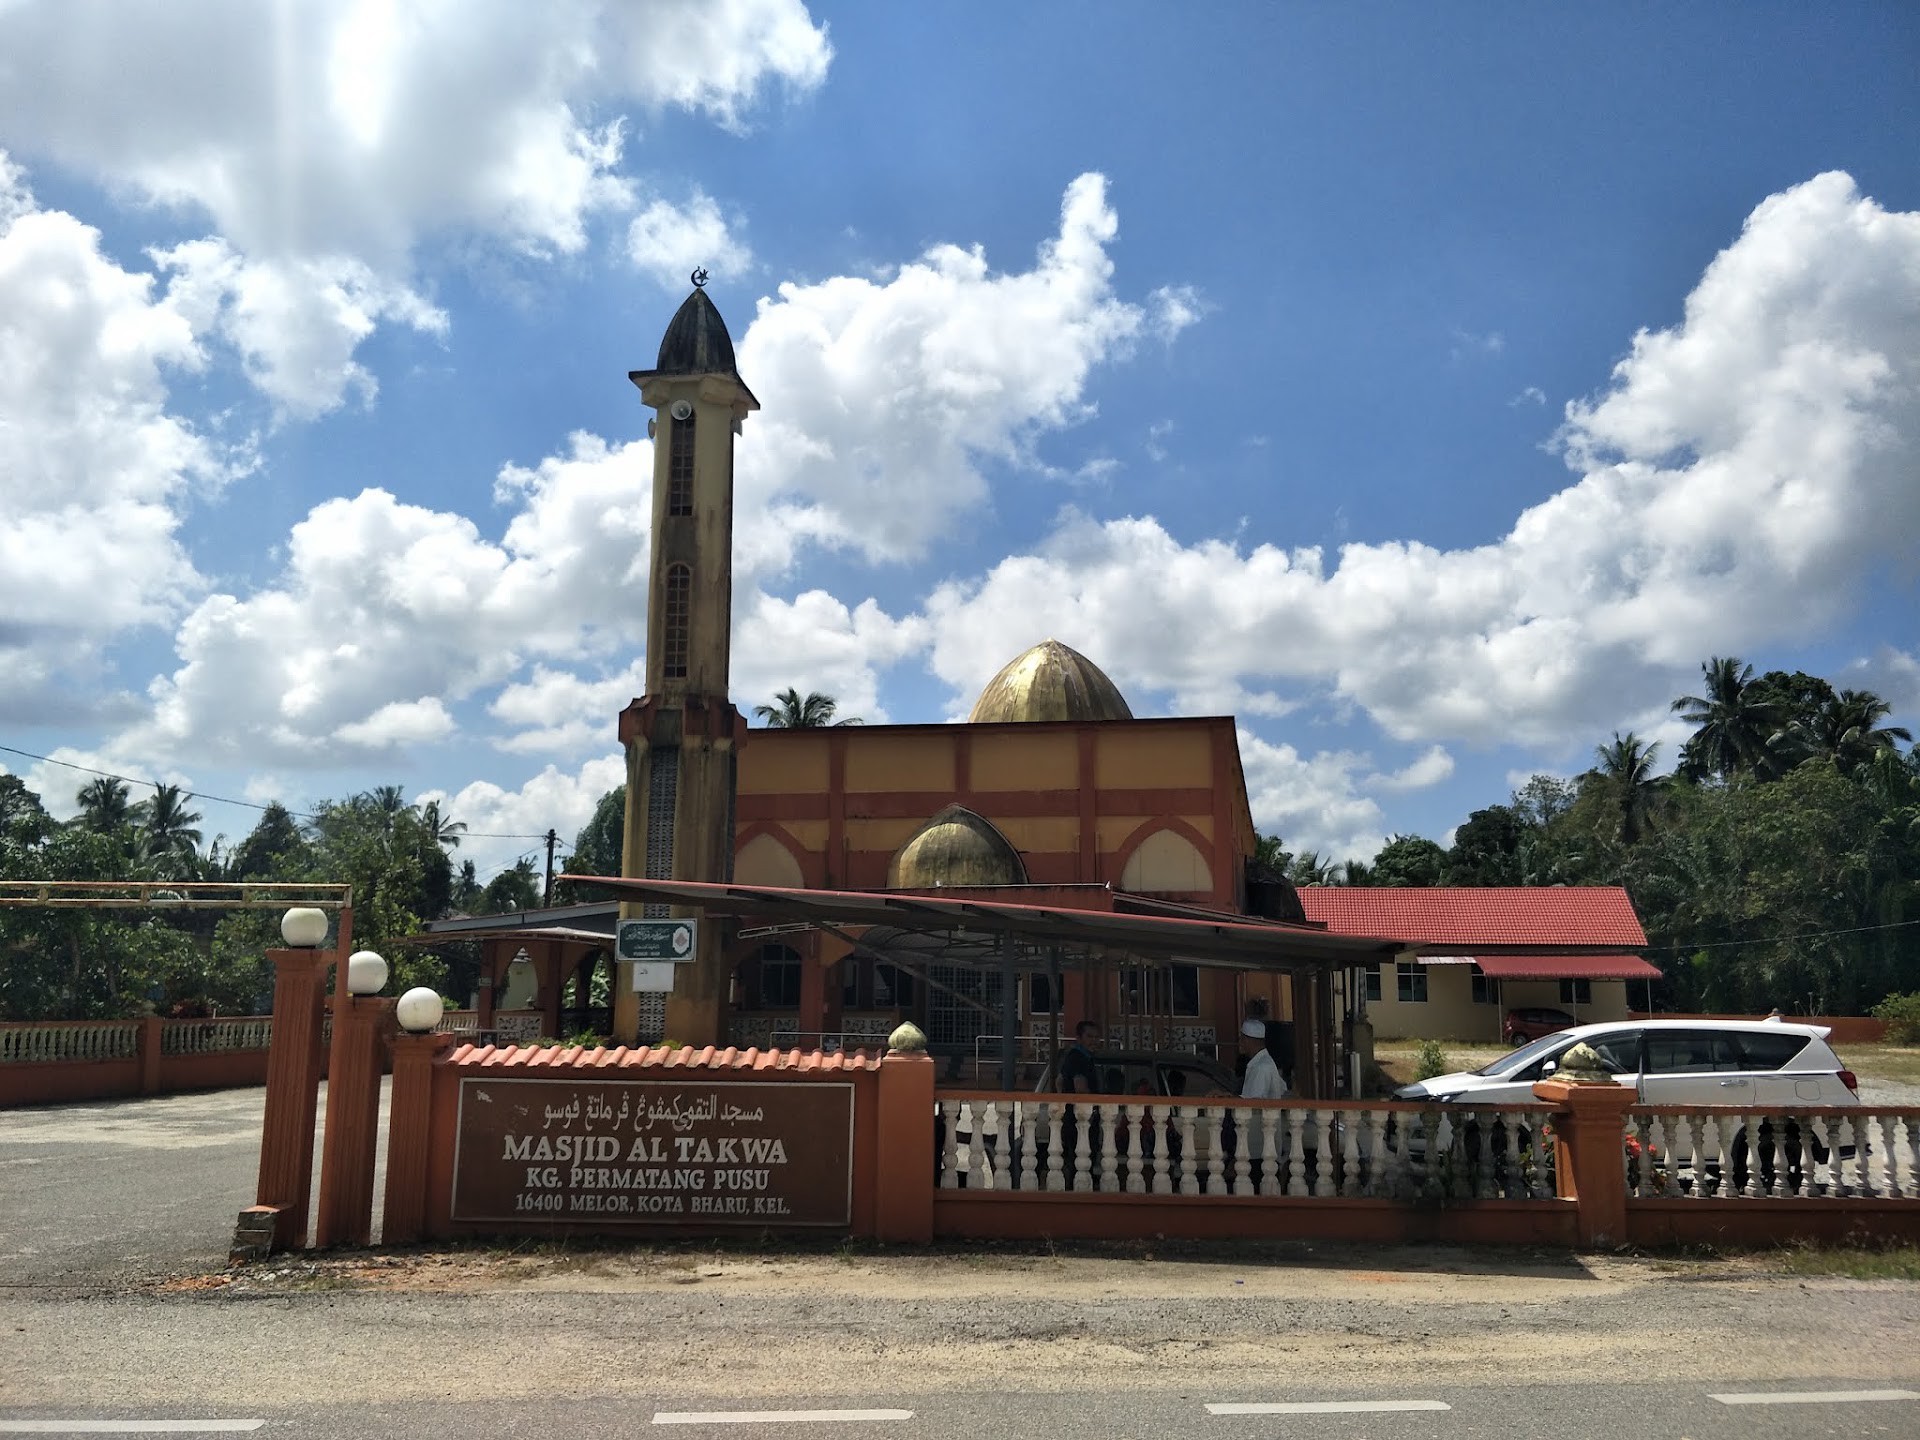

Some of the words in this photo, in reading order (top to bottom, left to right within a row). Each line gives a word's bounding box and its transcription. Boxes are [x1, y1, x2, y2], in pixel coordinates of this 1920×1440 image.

[542, 1093, 580, 1129] فوسو
[720, 1103, 764, 1127] مسجد
[502, 1134, 621, 1168] MASJID
[626, 1137, 668, 1162] AL
[674, 1137, 788, 1164] TAKWA
[525, 1167, 563, 1188] KG.
[569, 1168, 706, 1190] PERMATANG
[712, 1169, 770, 1190] PUSU
[515, 1193, 563, 1211] 16400
[570, 1195, 634, 1214] MELOR,
[637, 1195, 684, 1212] KOTA
[690, 1196, 750, 1215] BHARU,
[753, 1197, 791, 1215] KEL.
